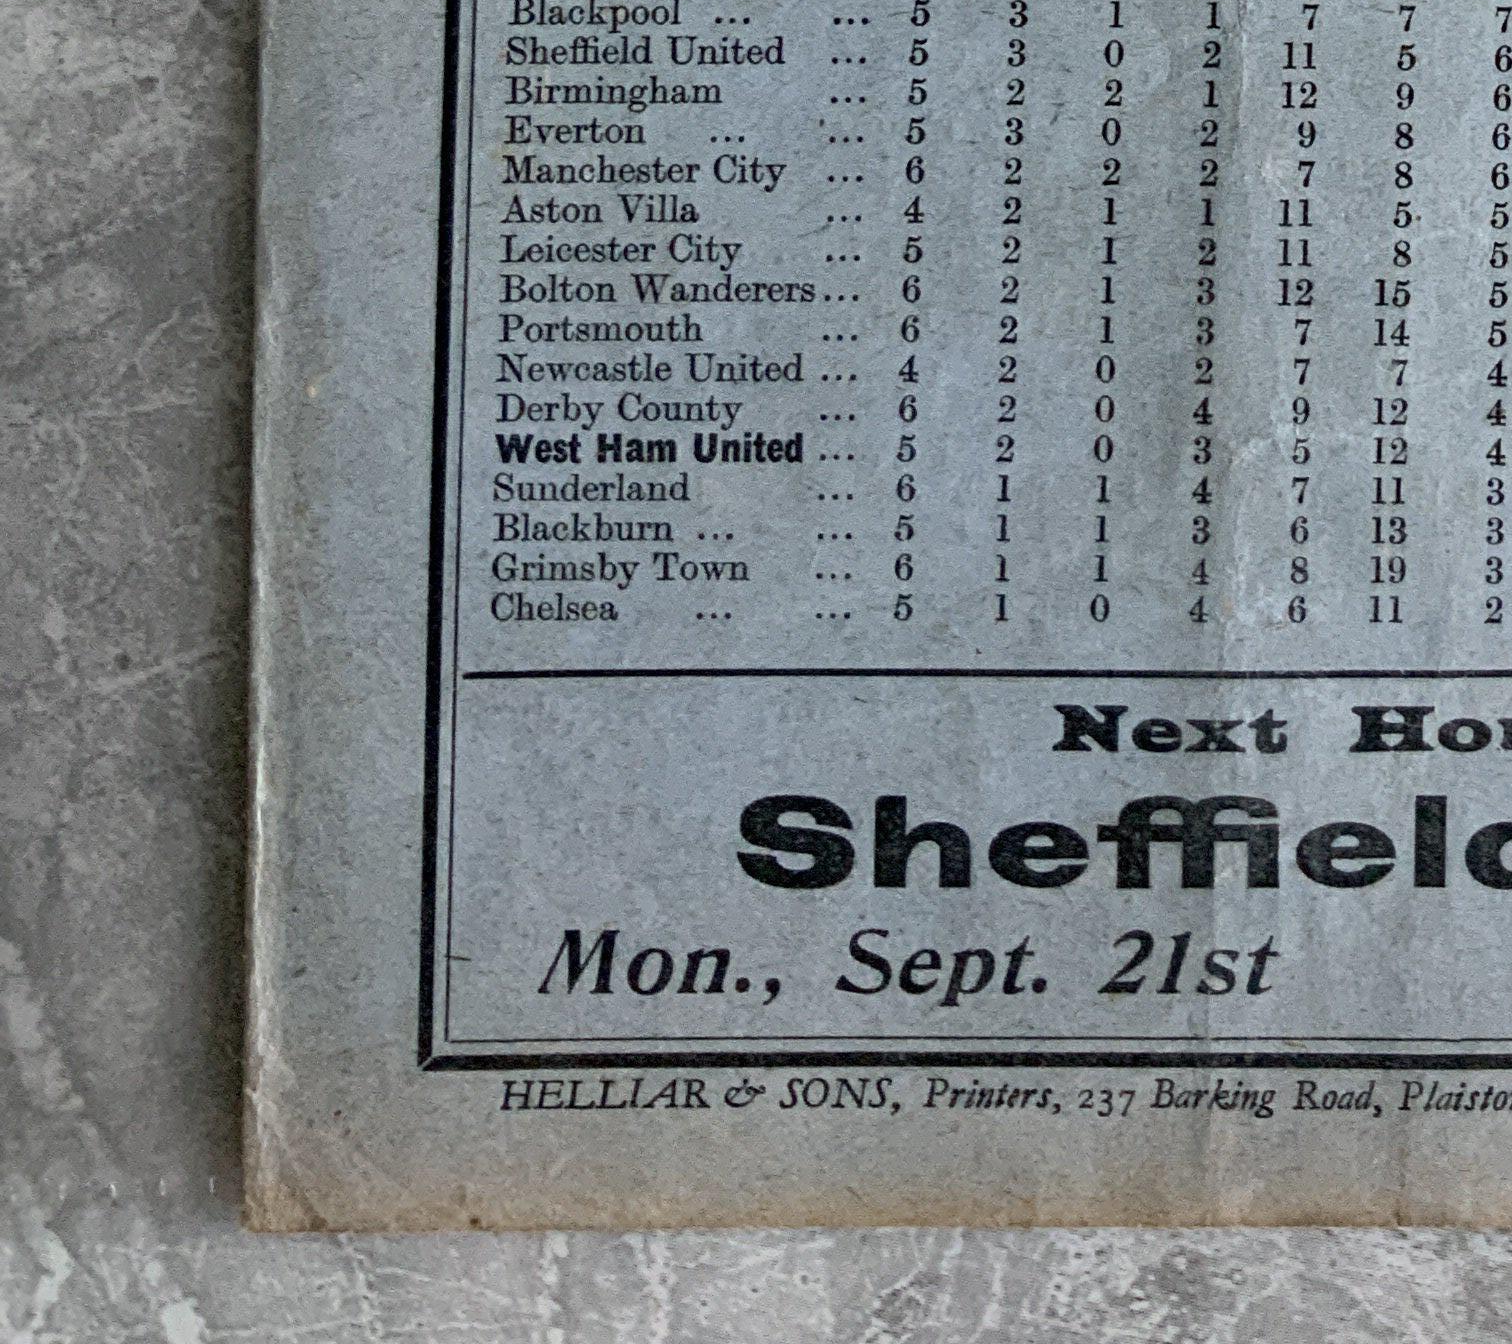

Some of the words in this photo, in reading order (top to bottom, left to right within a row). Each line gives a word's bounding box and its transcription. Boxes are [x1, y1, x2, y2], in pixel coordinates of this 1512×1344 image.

[503, 114, 647, 146] Everton
[500, 193, 604, 225] Aston
[616, 192, 700, 224] Villa
[495, 352, 673, 384] Newcastle
[684, 352, 805, 386] United
[897, 354, 920, 384] 4
[494, 432, 582, 465] West
[595, 432, 678, 464] Ham
[692, 431, 804, 464] United
[490, 591, 619, 623] Chelsea
[1051, 703, 1289, 755] Next
[537, 928, 782, 1006] Mon.,
[834, 927, 1048, 1008] Sept.
[1096, 929, 1281, 997] 21st
[499, 1076, 711, 1112] HELLIAR
[723, 1077, 767, 1109] &
[778, 1076, 902, 1117] SONS,
[922, 1076, 1062, 1116] Printers,
[1077, 1088, 1136, 1118] 237
[1149, 1077, 1277, 1119] Barking
[1291, 1079, 1383, 1119] Road,
